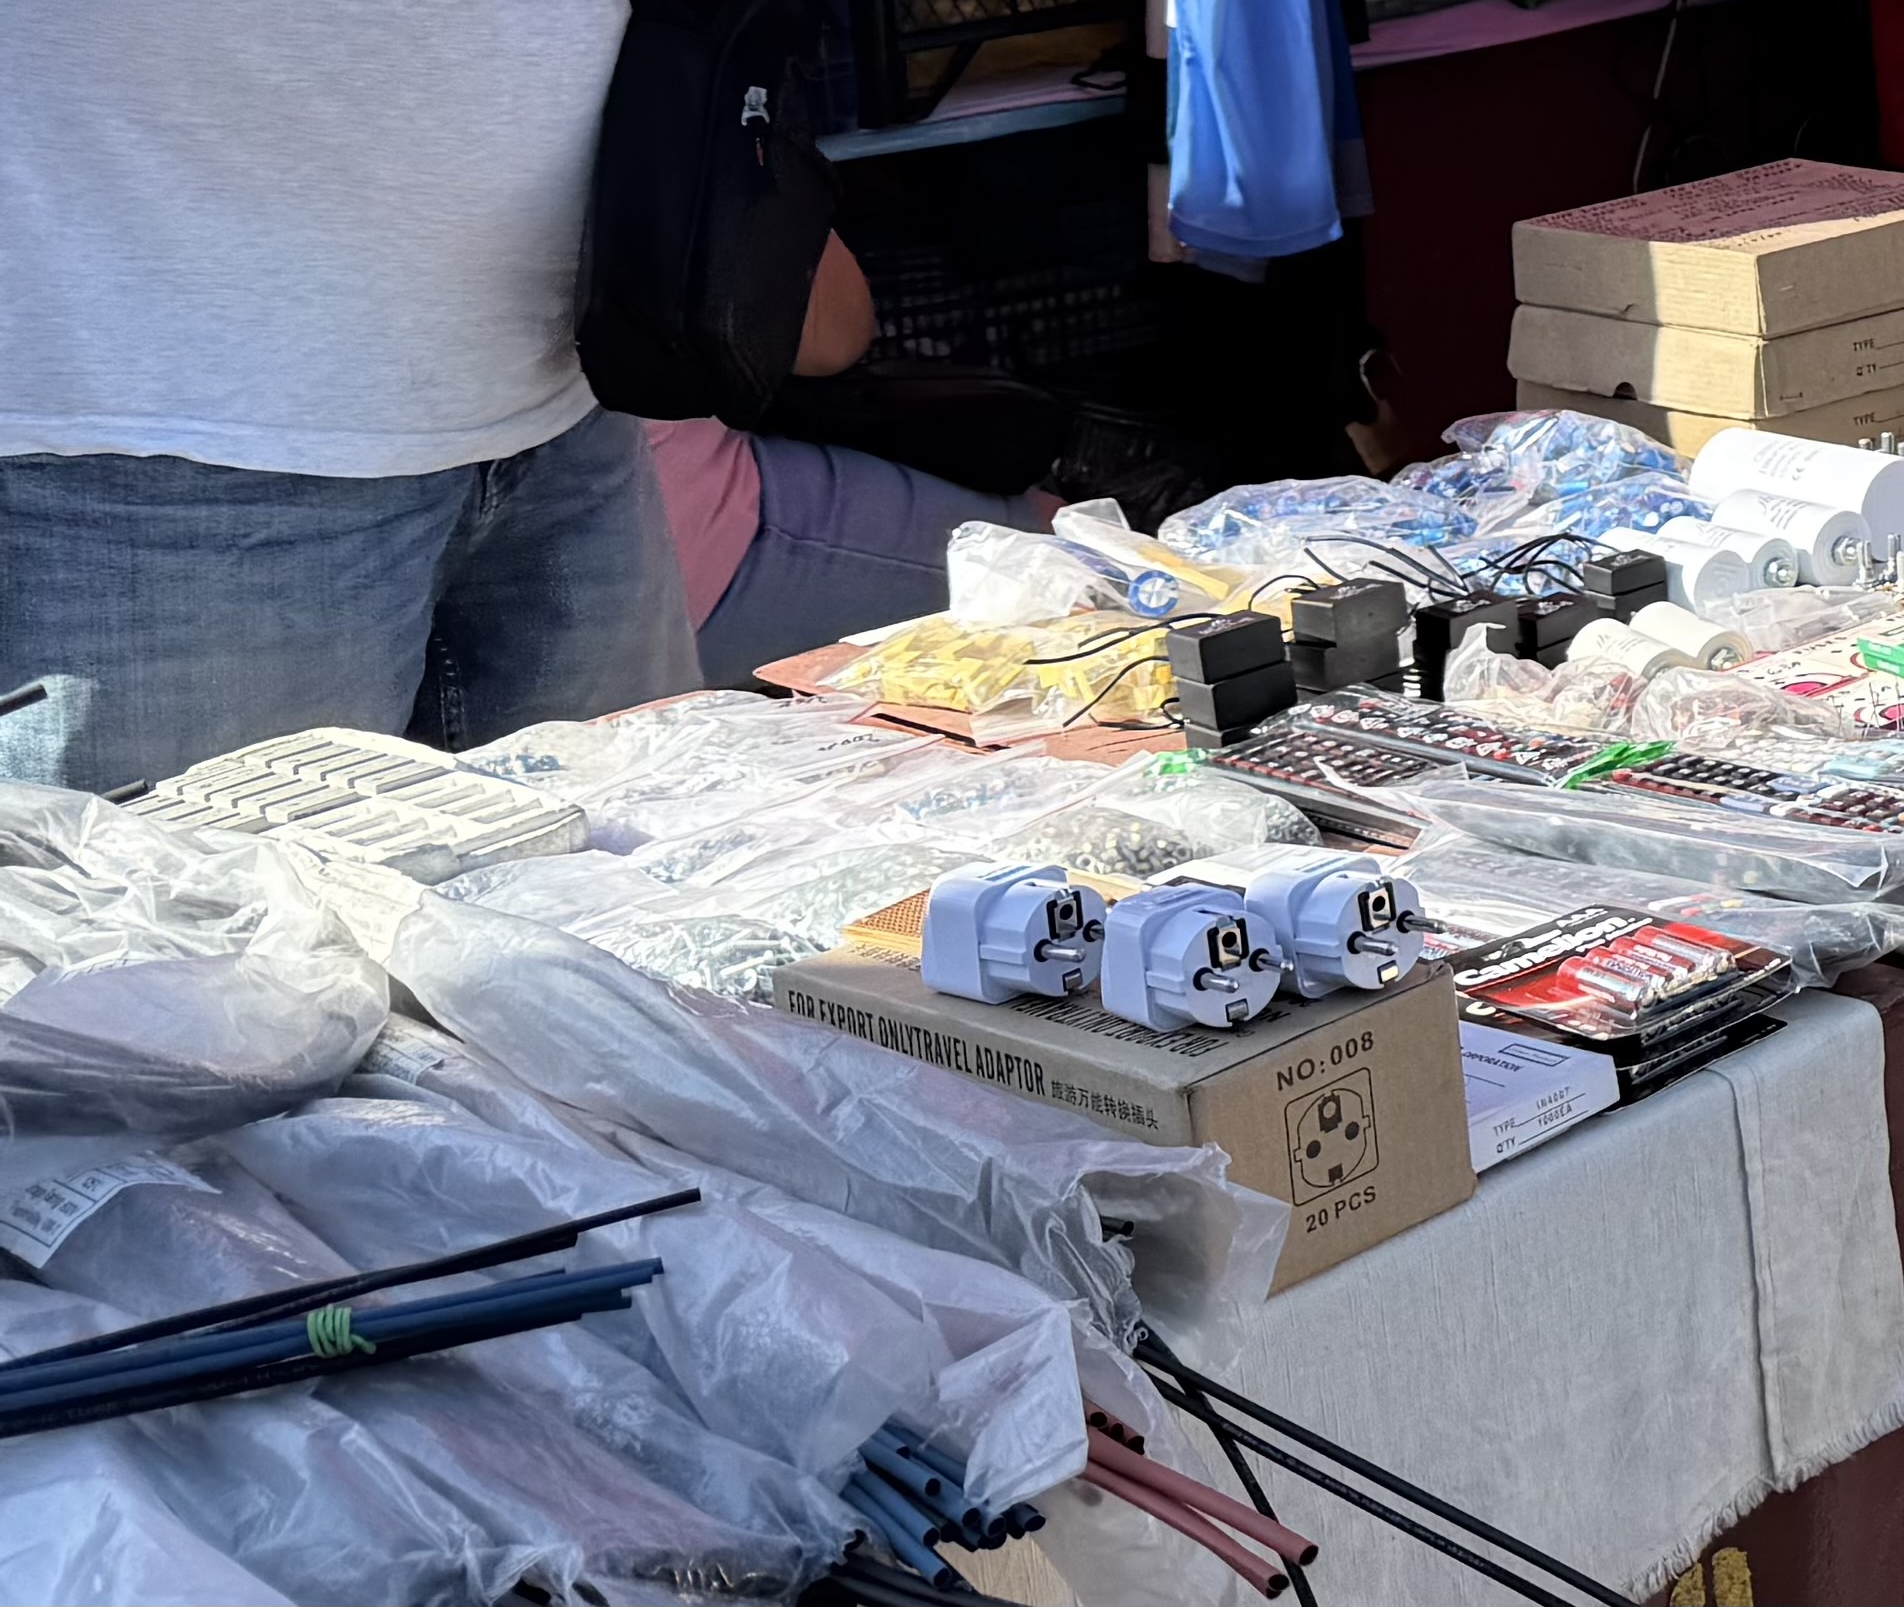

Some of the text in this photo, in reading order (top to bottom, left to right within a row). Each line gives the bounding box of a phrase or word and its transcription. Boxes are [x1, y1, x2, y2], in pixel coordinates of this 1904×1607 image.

[1853, 338, 1875, 352] TYPE
[1853, 412, 1876, 426] TYPE
[788, 990, 816, 1019] FOR
[819, 999, 875, 1044] EXPORT
[976, 1044, 1045, 1096] ADAPTOR
[1492, 1117, 1517, 1137] TYPE
[1305, 1185, 1377, 1234] 20 PCS
